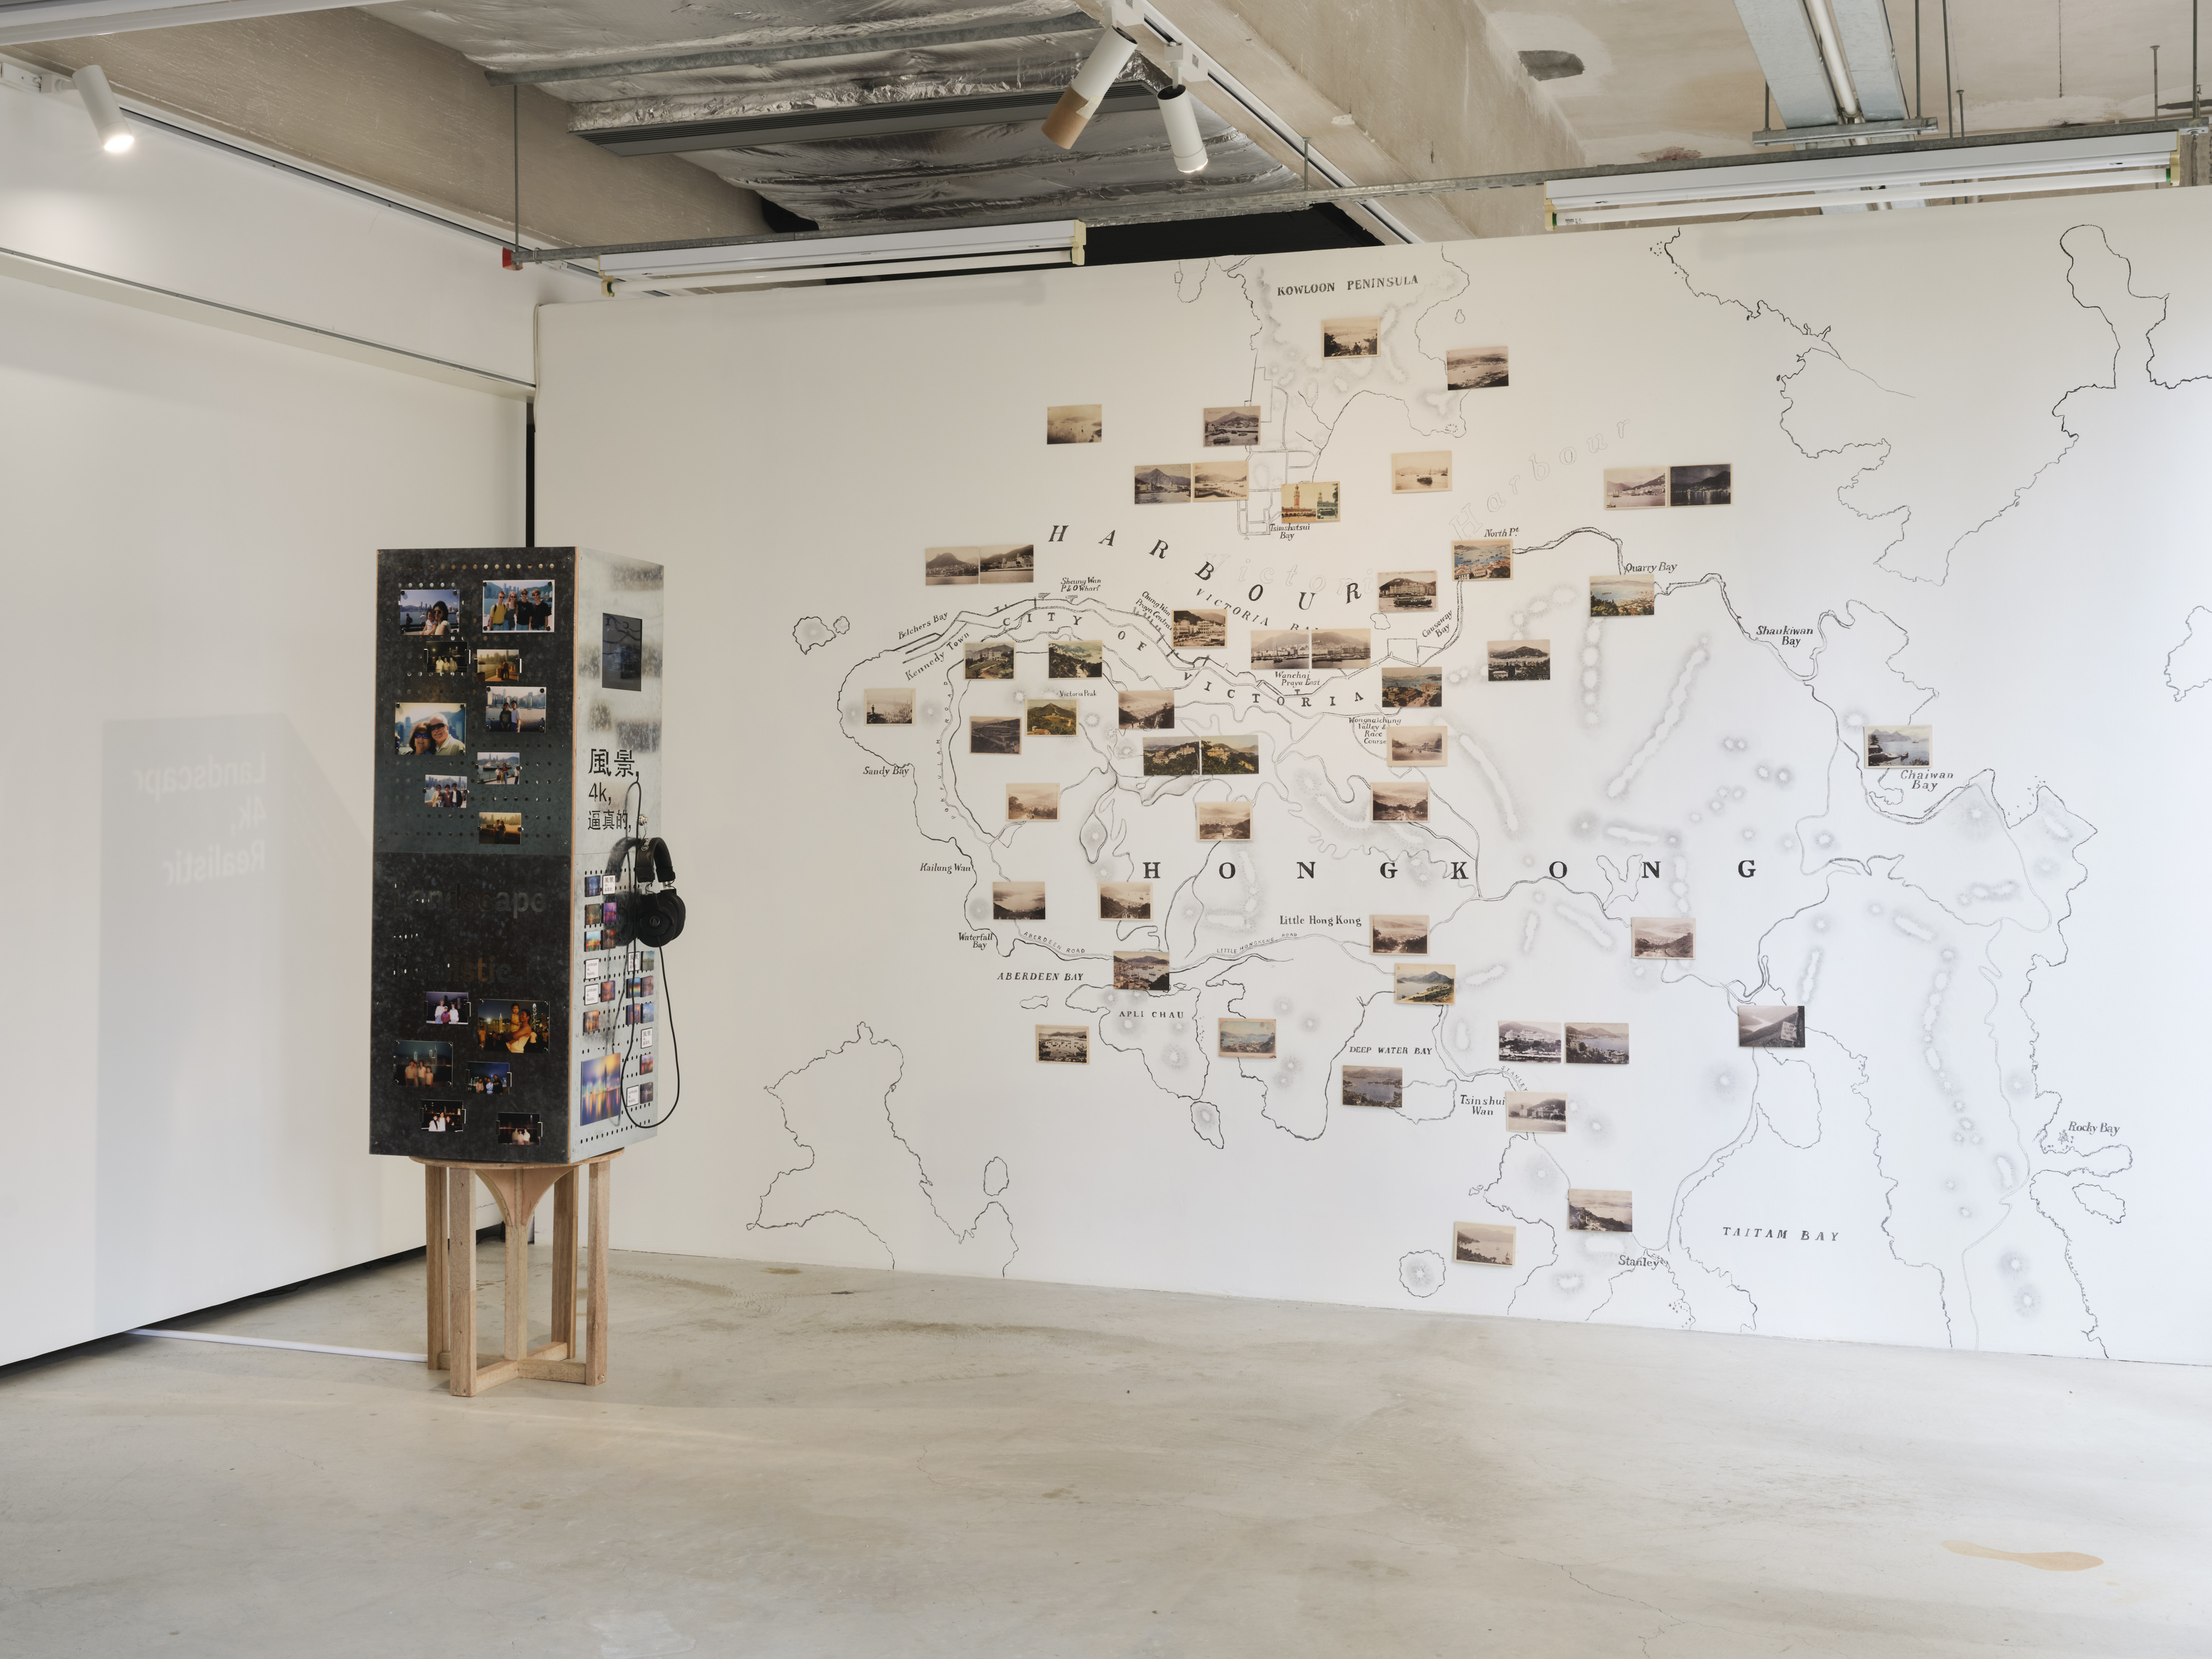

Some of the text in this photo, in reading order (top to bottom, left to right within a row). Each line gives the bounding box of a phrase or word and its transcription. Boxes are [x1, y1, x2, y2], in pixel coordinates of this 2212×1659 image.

[1278, 275, 1419, 296] KOWLOON PENINSULA
[1270, 523, 1310, 532] Tsimshatsui
[1484, 528, 1508, 537] North
[1280, 532, 1295, 541] Bay
[1626, 562, 1678, 574] Quarry Bay
[1135, 598, 1153, 614] Praya
[1142, 591, 1170, 617] Chung Wan
[898, 612, 948, 639] Belchers Bay
[1422, 610, 1452, 637] Causeway
[1435, 624, 1449, 637] Bay
[1756, 626, 1813, 636] Shaukiwan
[1781, 636, 1802, 648] Bay
[905, 632, 970, 681] Kennedy Town
[1003, 612, 1364, 707] CITY OF VICTORIA
[1275, 671, 1310, 679] Wanchai
[1281, 678, 1303, 688] Praya
[863, 765, 909, 777] Sandy Bay
[1901, 769, 1954, 781] Chaiwan
[1911, 779, 1938, 793] Bay
[588, 782, 612, 806] 4k,
[919, 863, 971, 875] Kailung Wan
[1279, 916, 1362, 927] Little Hong Kong
[958, 932, 993, 941] Waterfall
[1024, 931, 1062, 950] ABERDEEN
[972, 941, 987, 951] Bay
[1240, 937, 1275, 951] HONGKONG
[996, 972, 1085, 981] ABERDEEN BAY
[1151, 1010, 1184, 1019] CHAU
[1501, 1066, 1528, 1091] STANLEY
[1472, 1106, 1494, 1115] Wan
[2068, 1121, 2121, 1136] Rocky Bay
[1723, 1227, 1840, 1242] TAITAM BAY
[1618, 1255, 1660, 1270] Stanley
